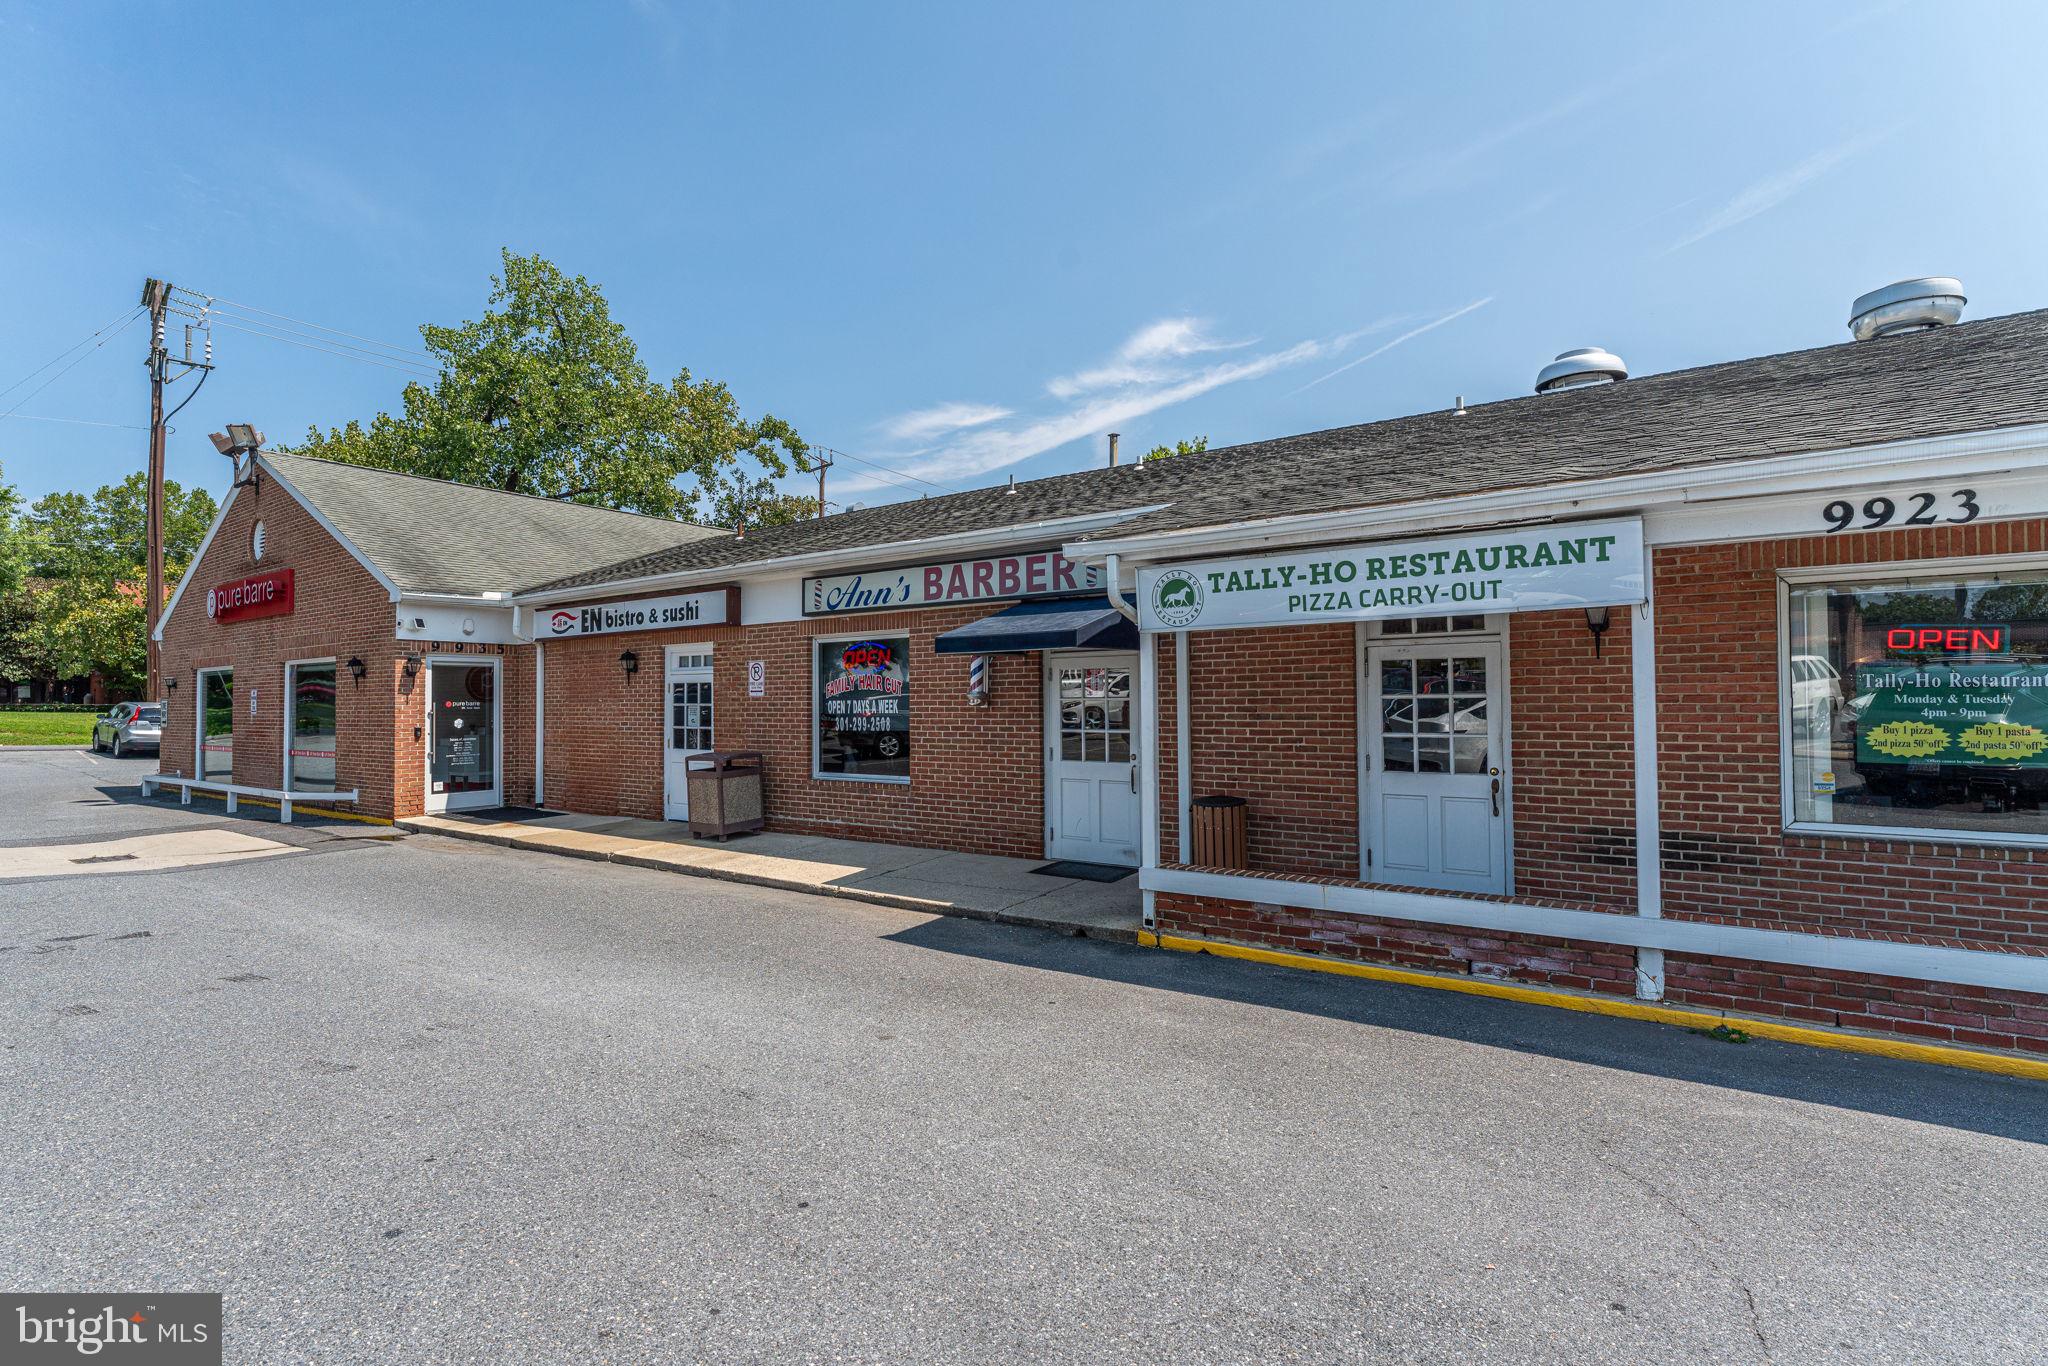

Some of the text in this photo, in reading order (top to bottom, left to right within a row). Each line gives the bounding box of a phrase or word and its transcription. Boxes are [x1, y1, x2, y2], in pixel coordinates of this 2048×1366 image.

[1823, 489, 1979, 533] 9923
[1207, 536, 1616, 593] TALLY-HO RESTAURANT
[826, 553, 1078, 611] Ann's BARBER
[1156, 572, 1198, 588] TALLY HO
[218, 587, 241, 616] pure
[243, 580, 274, 605] barre
[1288, 580, 1502, 613] PIZZA CARRY-OUT
[581, 607, 602, 632] EN
[605, 609, 644, 628] bistro
[648, 608, 658, 623] &
[662, 600, 699, 622] sushi
[1155, 600, 1202, 625] RESTAURANT
[431, 641, 504, 655] 9935
[1887, 629, 2000, 650] OPEN
[842, 648, 891, 668] OPEN
[826, 674, 903, 698] FAMILY HAIR CUT
[1862, 672, 2048, 691] Tally-Ho Restaurant
[828, 699, 899, 714] OPEN 7 DAYS A WEEK
[1894, 694, 2015, 706] Monday & Tuesday
[1921, 708, 1947, 719] 4pm
[1959, 708, 1986, 719] 9pm
[1883, 726, 1933, 737] Buy 1 pizza
[1976, 727, 2031, 738] Buy 1 pasta
[1890, 740, 1911, 749] pizza
[1965, 741, 1980, 749] 2nd
[1983, 742, 2006, 751] pasta
